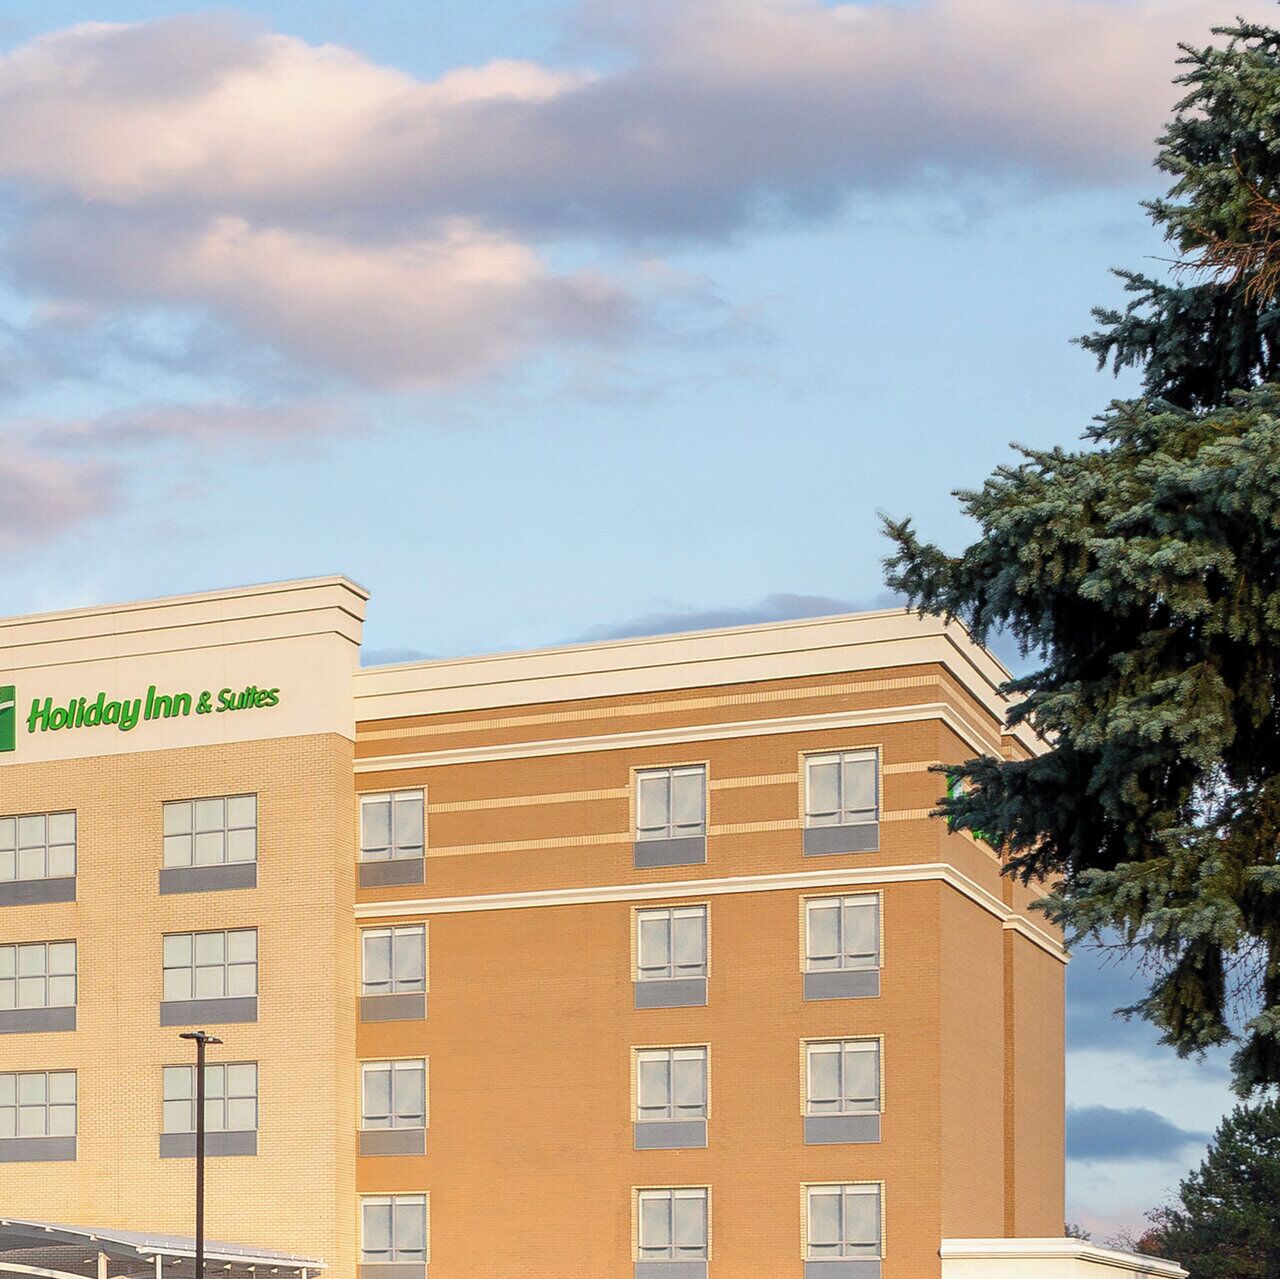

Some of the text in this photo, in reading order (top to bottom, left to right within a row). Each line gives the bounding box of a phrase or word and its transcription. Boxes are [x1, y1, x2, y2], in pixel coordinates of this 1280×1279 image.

[26, 685, 280, 733] Holiday Inn & Suites
